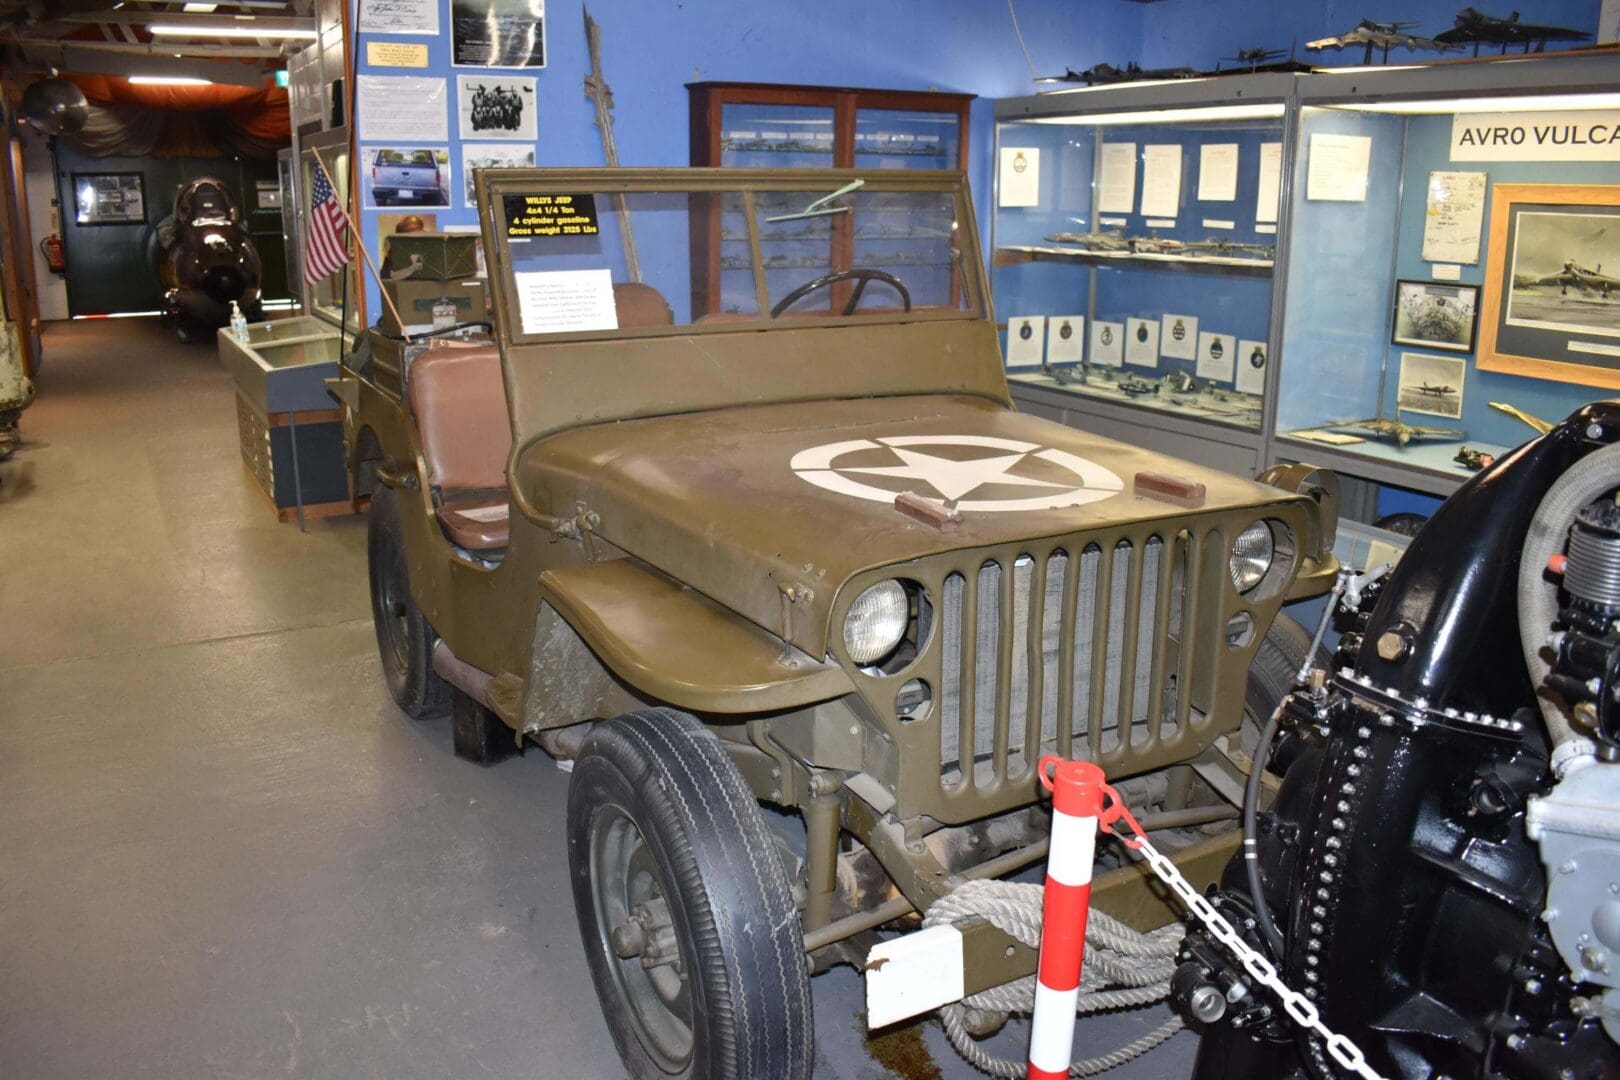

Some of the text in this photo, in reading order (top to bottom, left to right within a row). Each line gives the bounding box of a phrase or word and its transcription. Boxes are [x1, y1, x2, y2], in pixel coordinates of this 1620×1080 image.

[1459, 127, 1526, 145] AVRO
[525, 196, 572, 204] WILLYS JEEP
[526, 206, 575, 214] 4x4 1/4 Ton
[513, 215, 590, 226] 4 cylinder gasoline
[508, 227, 532, 235] Gross
[534, 226, 560, 236] weight
